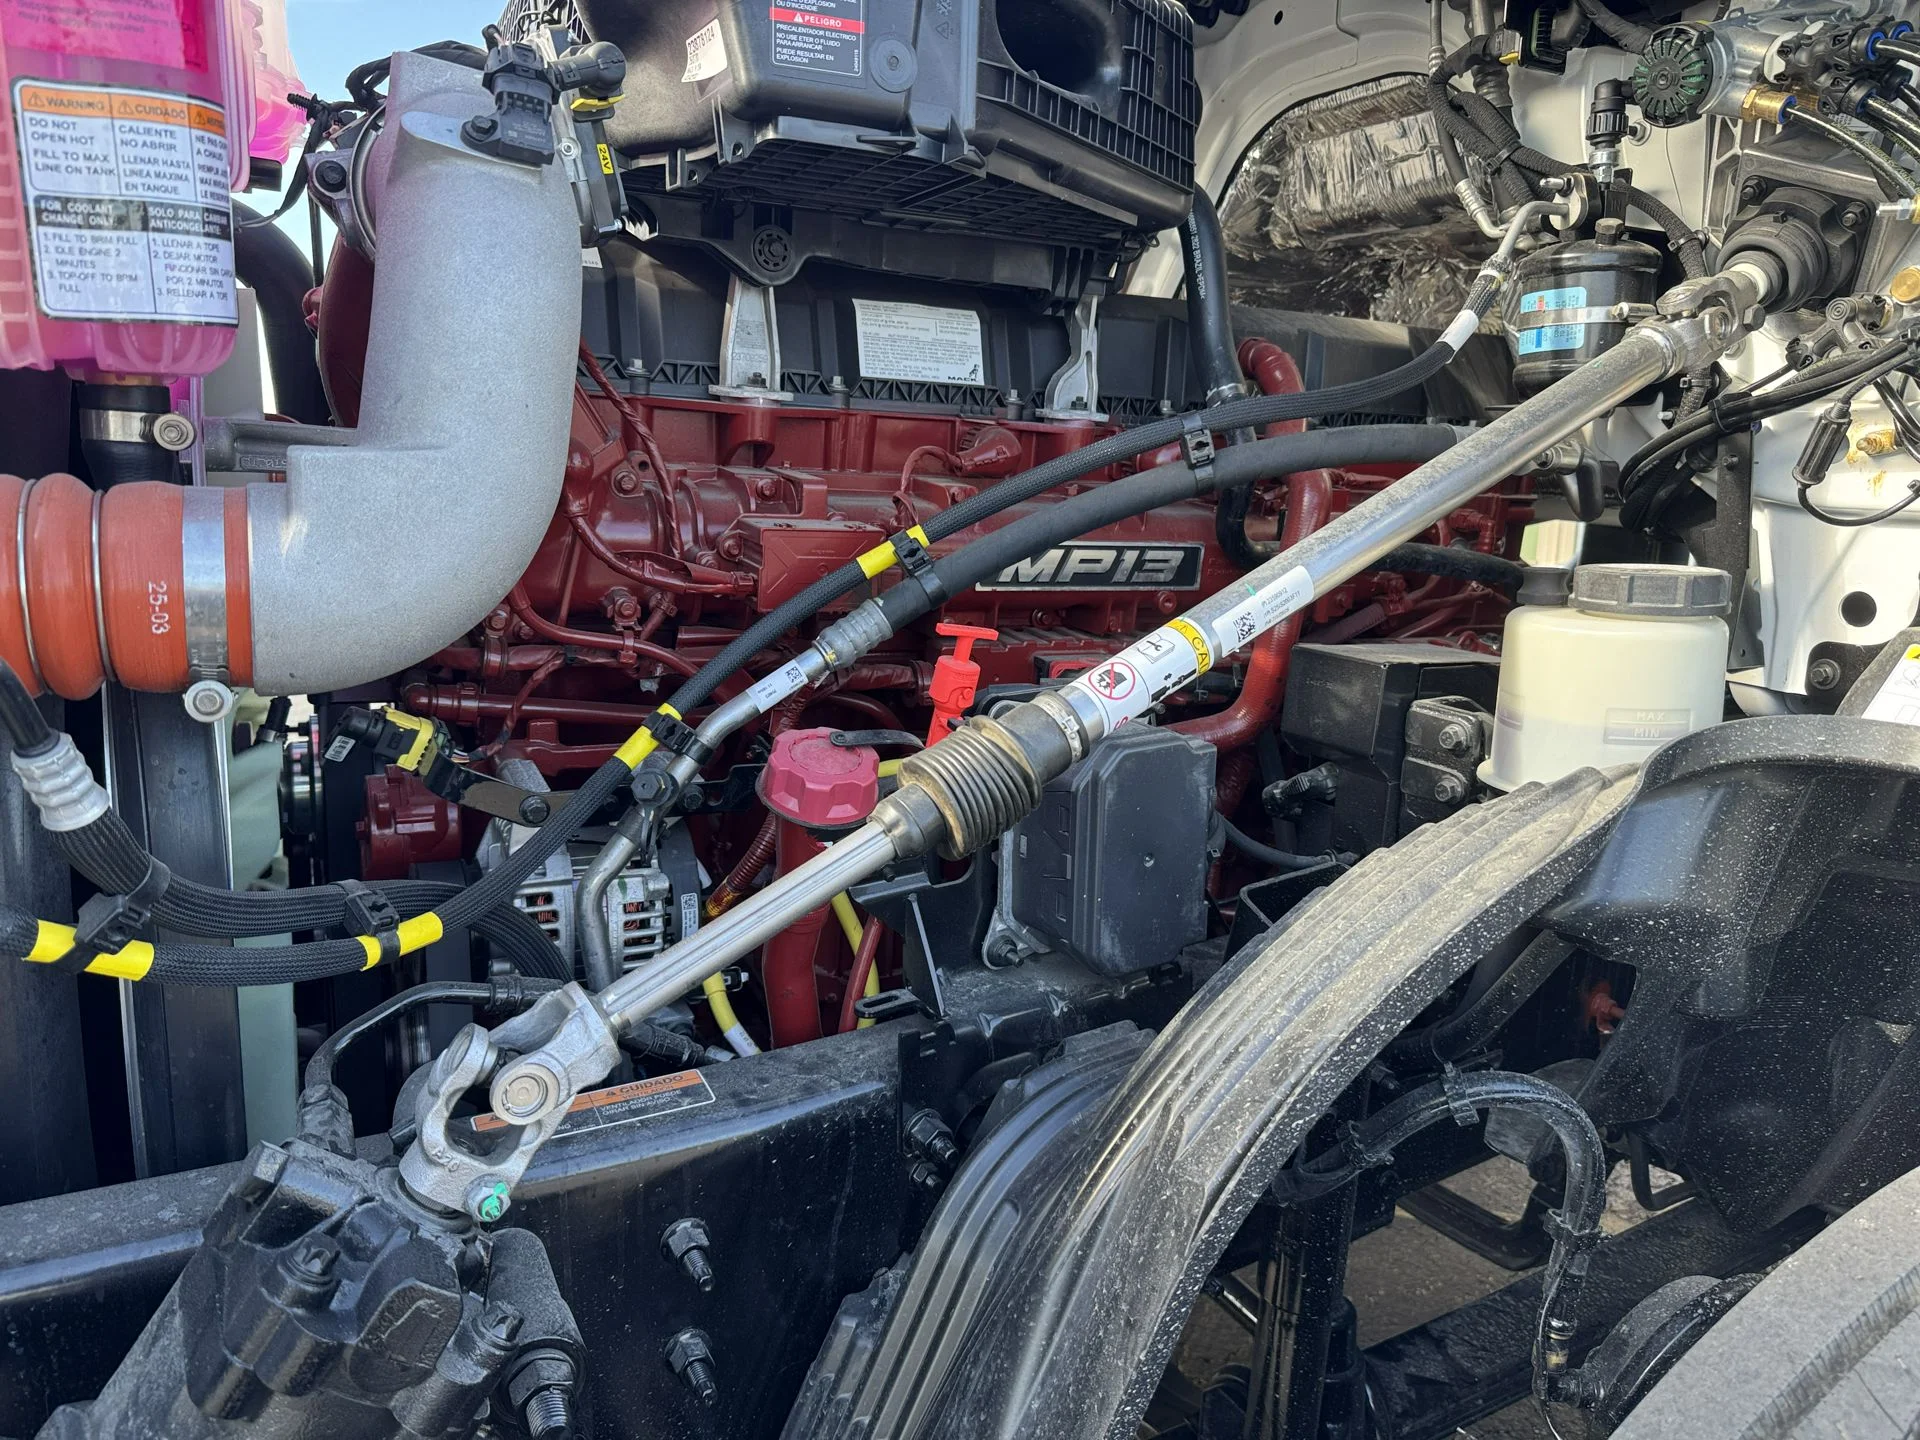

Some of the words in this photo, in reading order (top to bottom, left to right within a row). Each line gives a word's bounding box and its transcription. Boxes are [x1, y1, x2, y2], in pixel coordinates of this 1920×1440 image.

[804, 14, 842, 28] PELIGRO
[776, 23, 824, 36] PRECALENTADOR
[825, 31, 857, 42] ELECTRICO
[791, 41, 823, 51] ARRANCAR
[820, 39, 841, 48] FLUIDO
[776, 47, 796, 55] PUEDE
[796, 50, 825, 60] RESULTAR
[776, 53, 809, 63] EXPLOSION
[46, 97, 104, 111] WARNING
[135, 104, 186, 119] CUIDADO
[29, 117, 48, 128] DO
[51, 119, 77, 130] NOT
[31, 131, 66, 143] OPEN
[70, 135, 95, 145] HOT
[118, 124, 177, 139] CALIENTE
[120, 139, 138, 148] NO
[141, 140, 178, 152] ABRIR
[33, 148, 60, 160] FILL
[62, 151, 79, 161] TO
[83, 152, 110, 163] MAX
[121, 155, 160, 166] LLENAR
[162, 158, 191, 169] HASTA
[598, 147, 612, 170] 24V
[35, 162, 62, 174] LINE
[65, 164, 82, 175] ON
[123, 168, 152, 179] LINEA
[154, 170, 191, 183] MAXIMA
[125, 182, 138, 191] EN
[141, 183, 180, 195] TANQUE
[67, 202, 113, 215] COOLANT
[149, 207, 174, 218] SOLO
[178, 209, 200, 220] PARA
[42, 212, 84, 225] CHANGE
[52, 232, 72, 243] FILL
[75, 234, 87, 243] TO
[116, 235, 138, 245] FULL
[55, 258, 96, 269] MINUTES
[1193, 249, 1203, 274] BRAZIL
[100, 273, 113, 282] TO
[58, 283, 81, 293] FULL
[997, 548, 1185, 583] MP13
[149, 580, 169, 634] 25-03
[1636, 711, 1665, 721] MAX
[1633, 727, 1661, 738] MIN
[619, 1075, 684, 1094] CUIDADO
[600, 1096, 653, 1111] VENTILADOR
[654, 1089, 683, 1099] PUEDE
